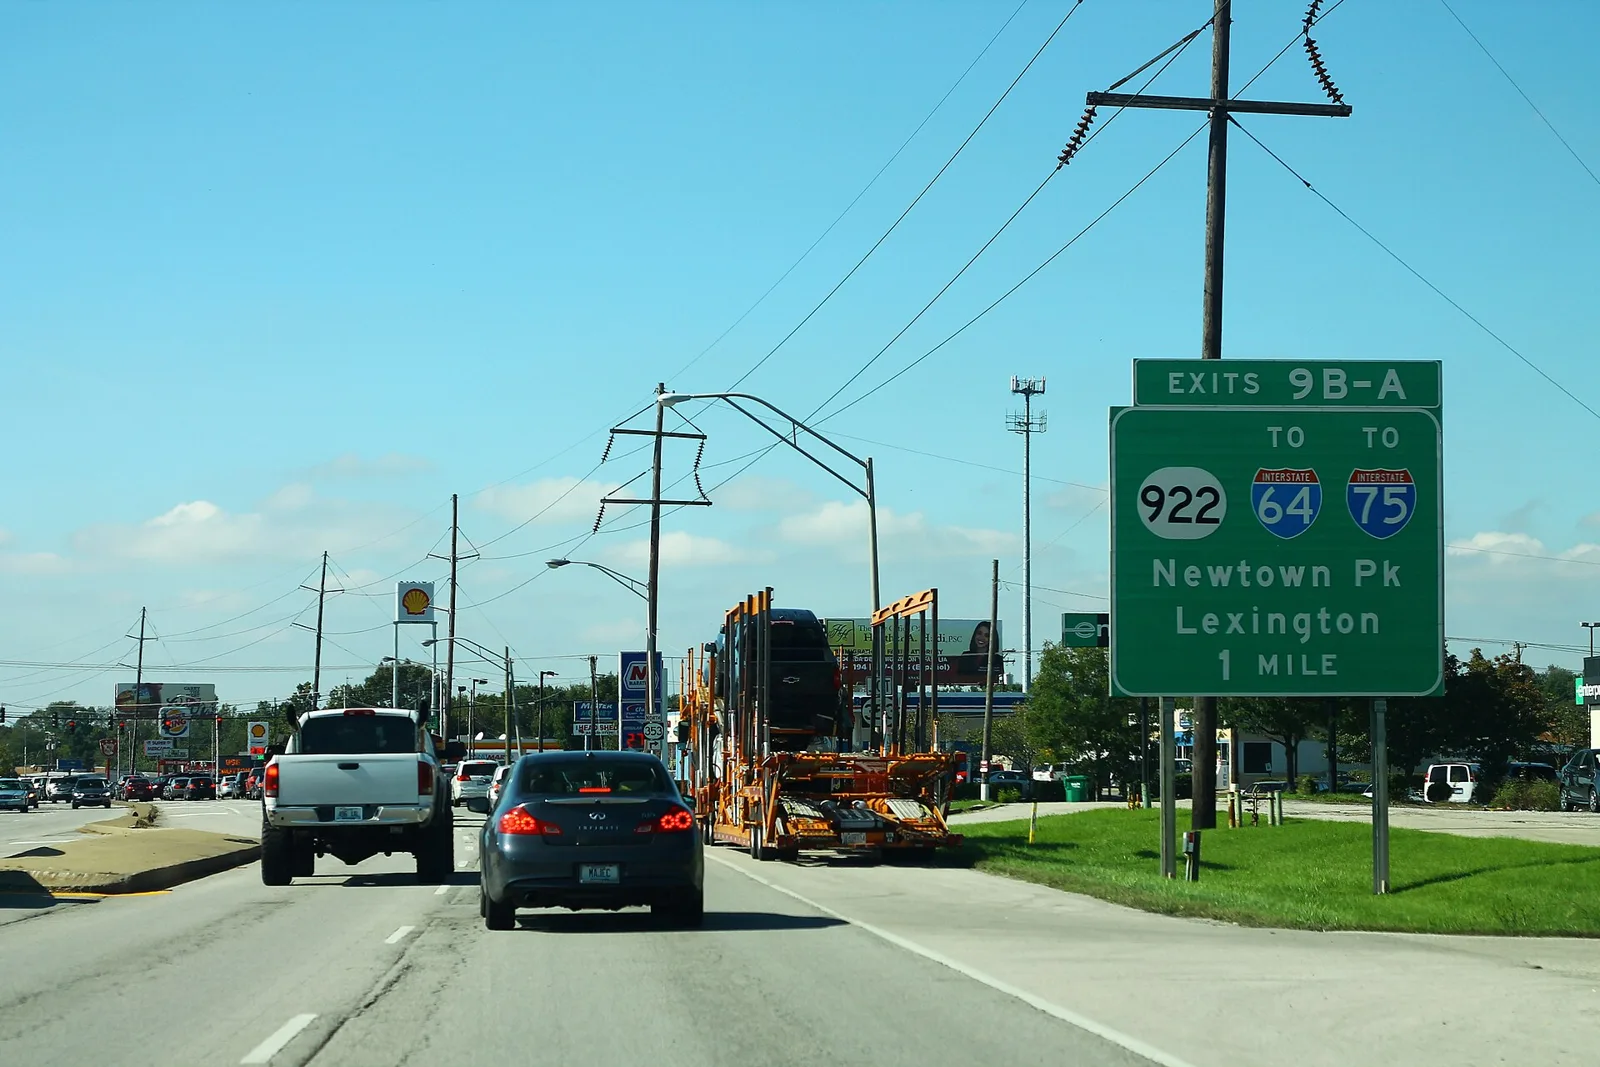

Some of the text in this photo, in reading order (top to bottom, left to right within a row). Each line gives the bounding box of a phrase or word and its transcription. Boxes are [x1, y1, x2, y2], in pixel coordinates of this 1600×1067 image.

[1168, 368, 1407, 400] EXITS 9B-A
[1266, 426, 1400, 448] TO TO
[1262, 472, 1311, 483] INTERSTATE
[1357, 472, 1405, 483] INTERSTATE
[1140, 485, 1221, 524] 922
[1258, 486, 1314, 524] 64
[1353, 486, 1408, 524] 75
[1152, 559, 1402, 587] Newtown Pk
[1176, 606, 1380, 644] Lexington
[1218, 649, 1338, 681] 1 MILE
[644, 726, 663, 736] 353
